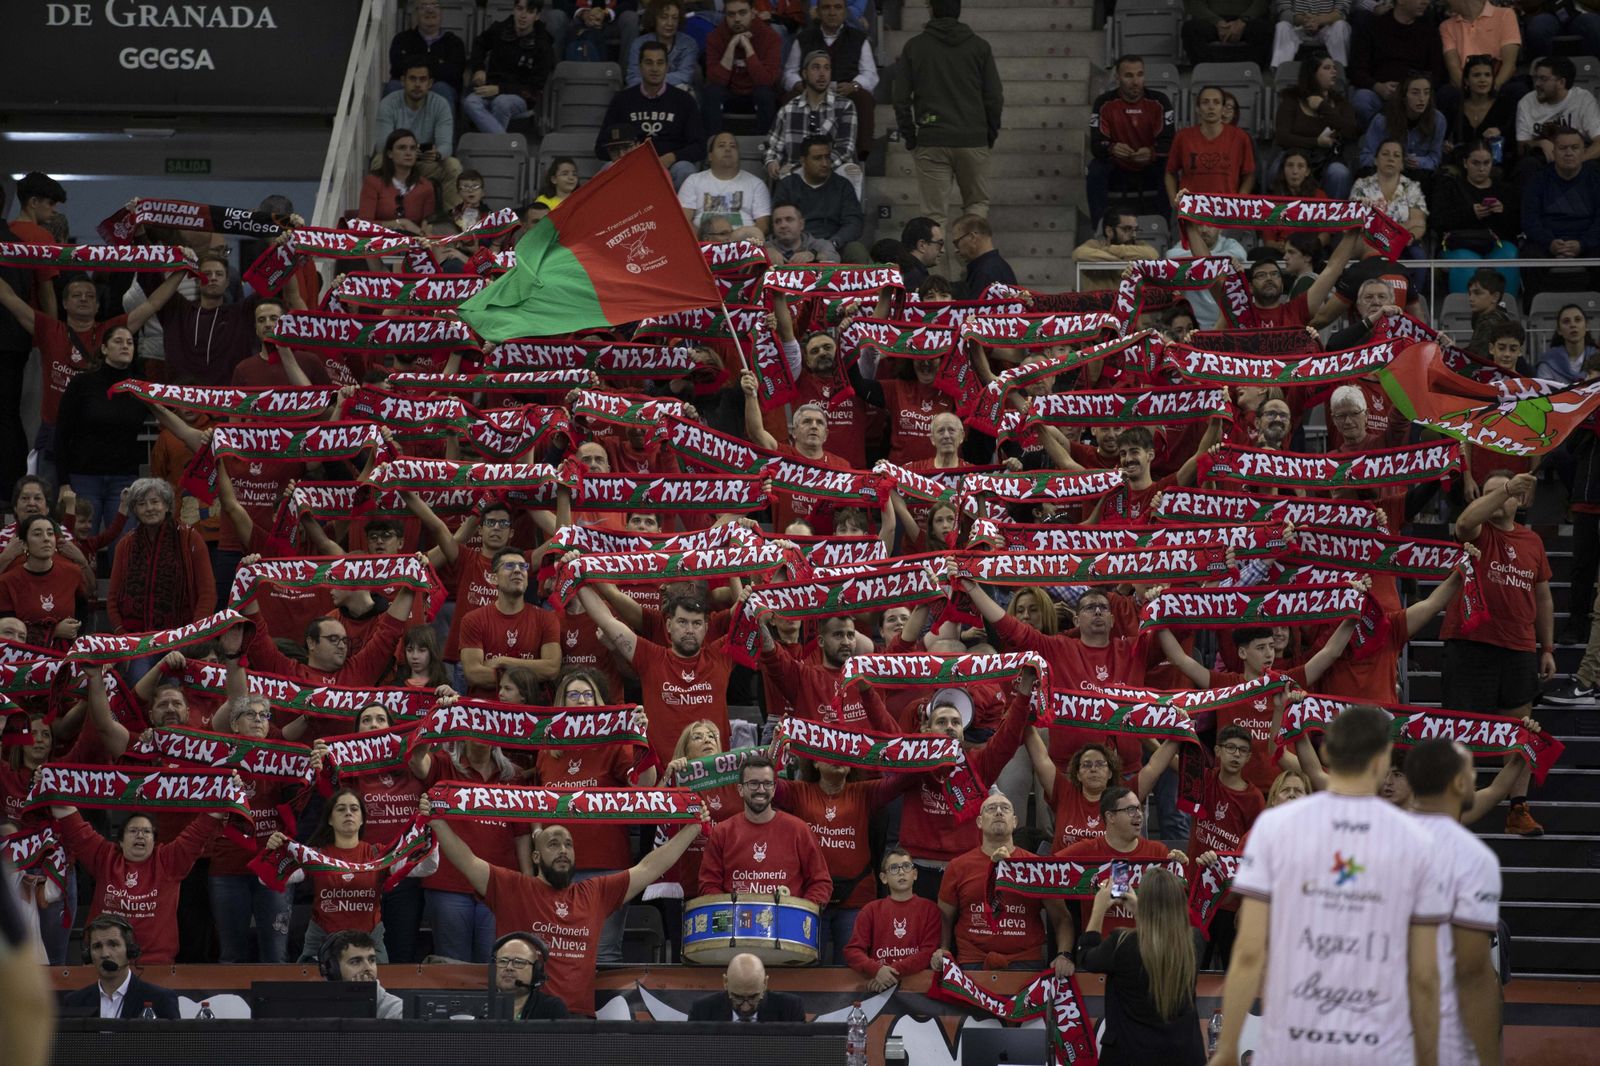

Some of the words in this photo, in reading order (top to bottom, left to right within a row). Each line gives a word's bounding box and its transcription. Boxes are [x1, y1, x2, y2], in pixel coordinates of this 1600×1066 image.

[46, 4, 92, 26] DE
[630, 112, 674, 121] SILBON
[166, 160, 210, 172] SALIDA
[224, 207, 252, 220] liga
[224, 219, 279, 233] endesa
[1290, 1027, 1379, 1044] VOLVO
